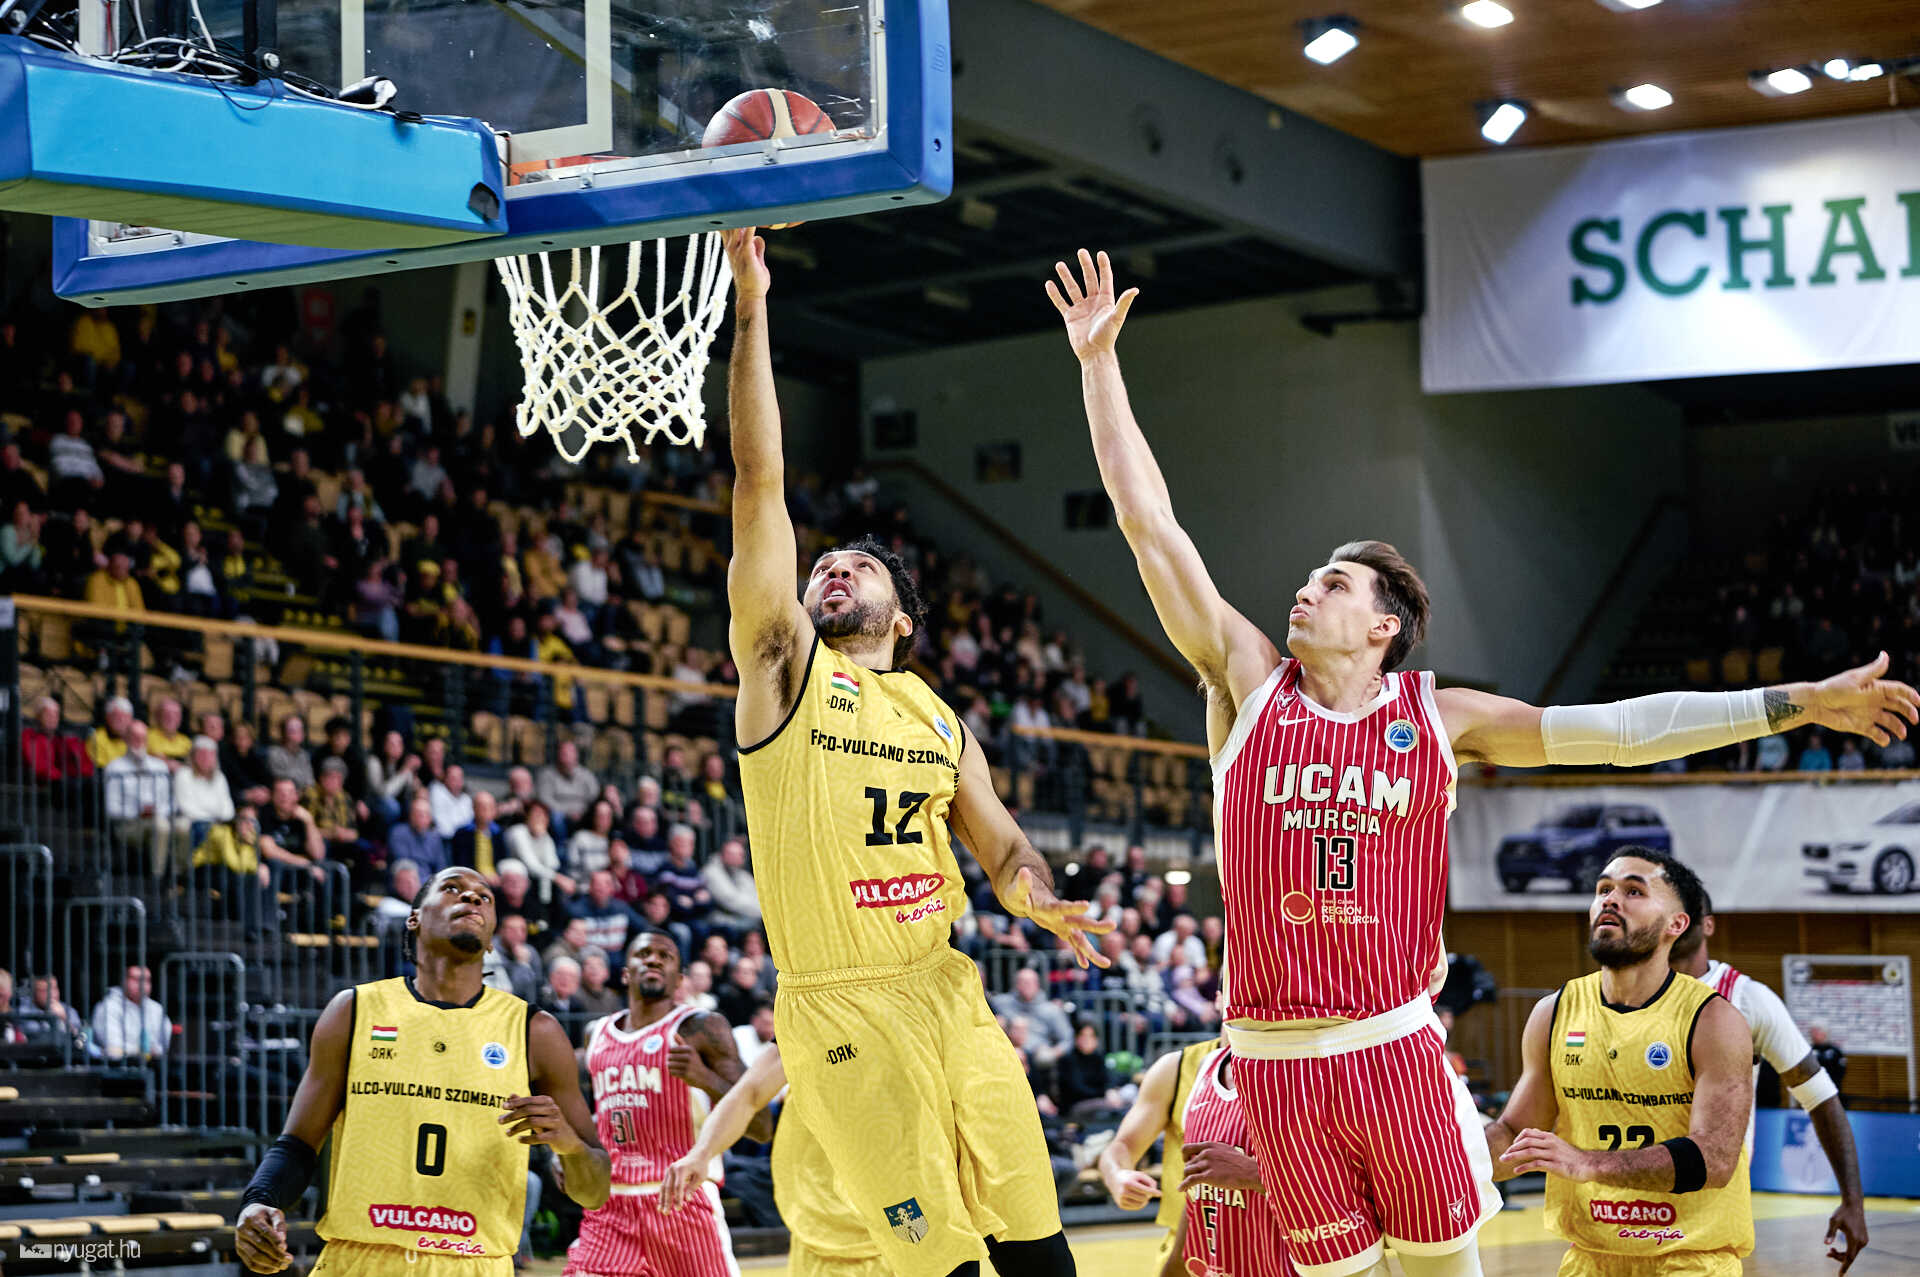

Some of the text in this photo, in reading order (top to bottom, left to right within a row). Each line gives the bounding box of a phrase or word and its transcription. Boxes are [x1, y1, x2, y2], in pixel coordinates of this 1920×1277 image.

[1262, 763, 1412, 818] UCAM
[864, 786, 931, 847] 12
[1282, 808, 1381, 837] MURCIA
[1313, 834, 1357, 892] 13
[1321, 915, 1379, 926] DE MURCIA
[611, 1109, 637, 1144] 31
[415, 1122, 448, 1177] 0
[371, 1207, 475, 1233] VULCANO
[1590, 1202, 1673, 1223] VULCANO
[417, 1235, 486, 1256] energia
[1618, 1227, 1685, 1246] energia
